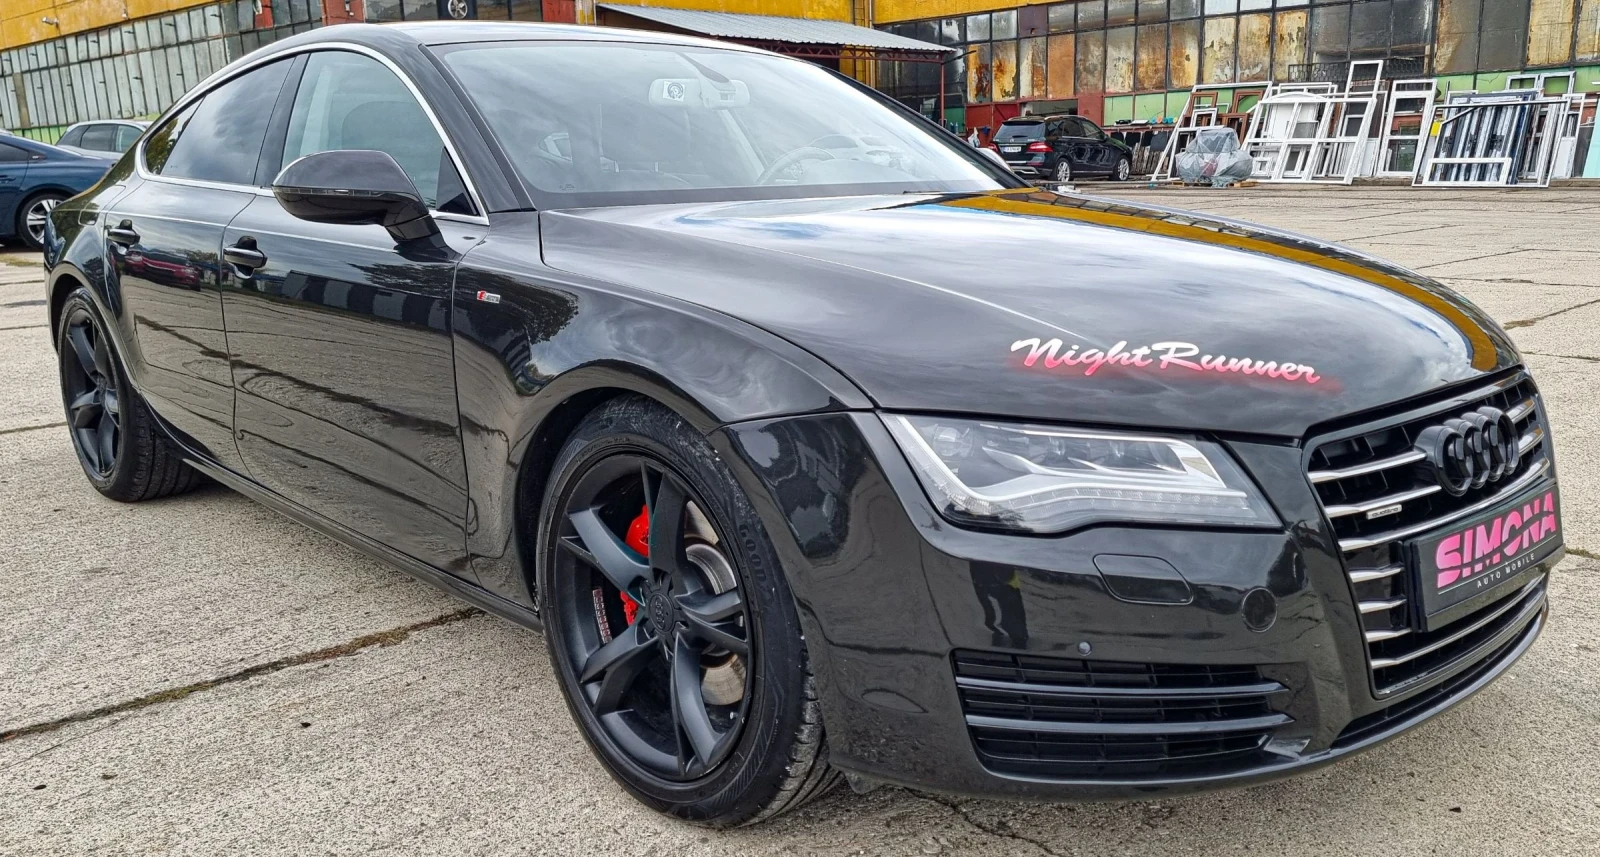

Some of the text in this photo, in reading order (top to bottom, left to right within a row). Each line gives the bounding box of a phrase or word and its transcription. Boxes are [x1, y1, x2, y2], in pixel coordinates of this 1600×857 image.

[1436, 492, 1557, 588] SIMONA
[1476, 553, 1536, 588] AUTO MOBILE
